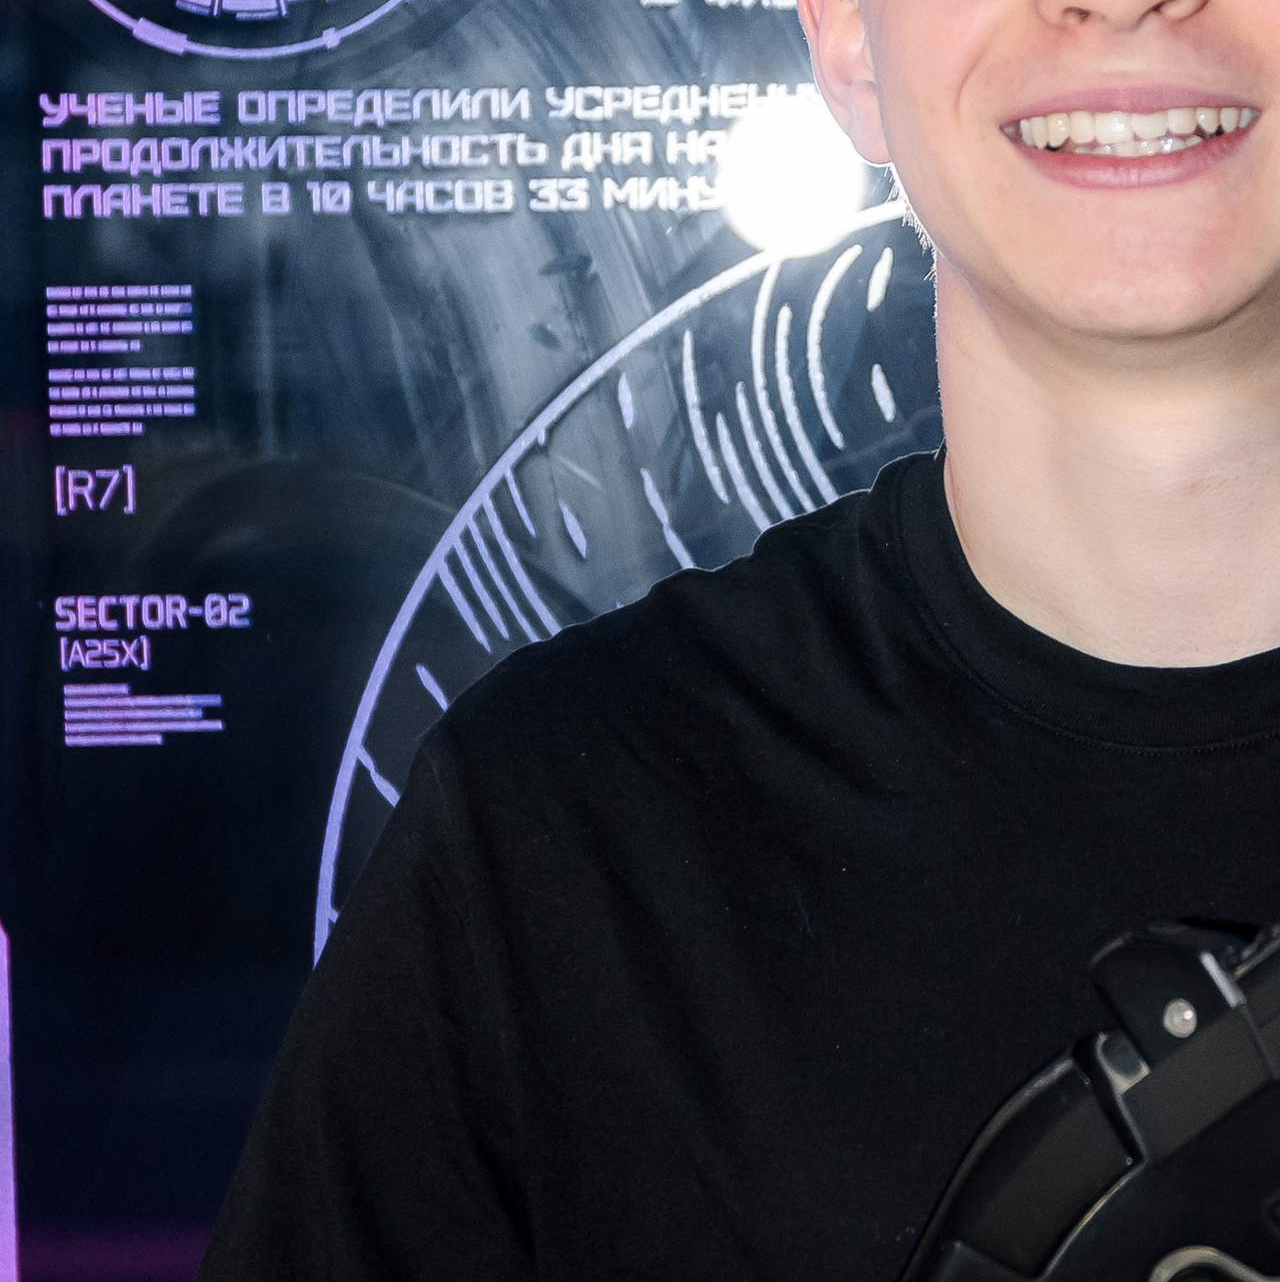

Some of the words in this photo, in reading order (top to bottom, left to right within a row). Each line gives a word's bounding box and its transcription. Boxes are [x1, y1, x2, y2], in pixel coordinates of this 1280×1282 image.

[39, 91, 221, 128] УЧЕНЫЕ
[238, 88, 530, 128] ОПРЕДЕЛИЛИ
[42, 133, 549, 177] ПРОДОЛЖИТЕЛЬНОСТЬ
[561, 131, 653, 172] ДНЯ
[43, 184, 244, 219] ПЛАНЕТЕ
[261, 182, 290, 216] В
[306, 180, 352, 215] 10
[367, 178, 514, 214] ЧАСОВ
[529, 177, 590, 211] 33
[55, 465, 136, 515] [R7]
[54, 593, 251, 630] SECTOR-02
[60, 635, 150, 670] [A25X]
